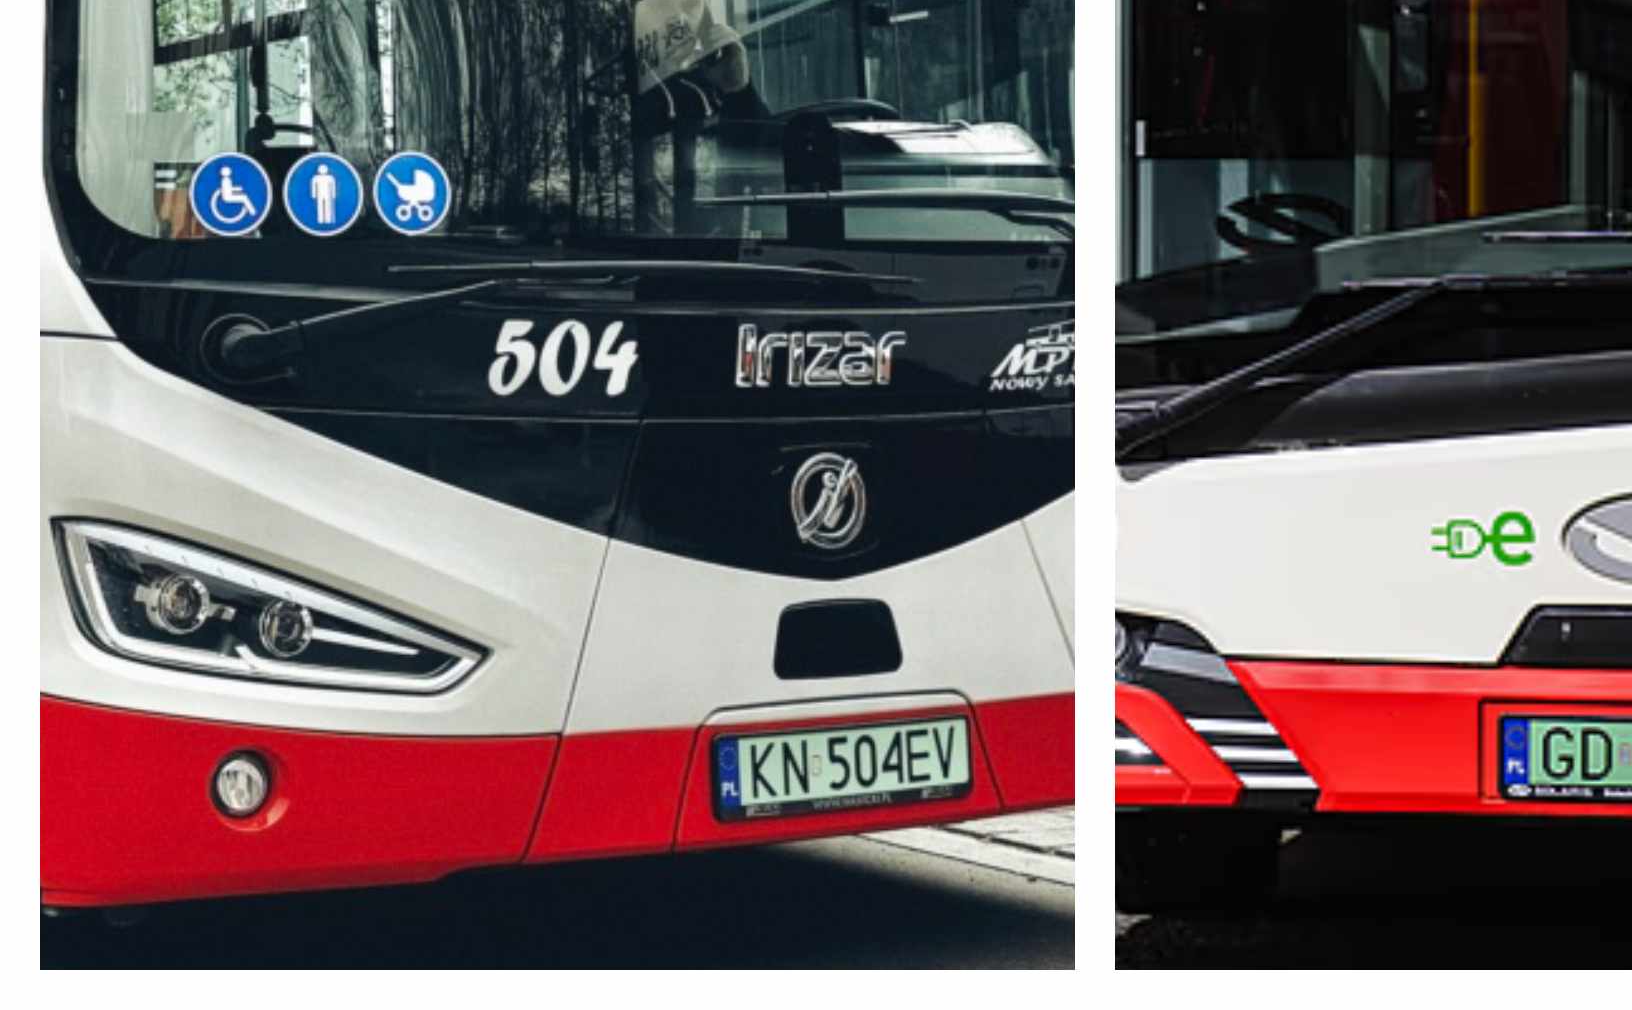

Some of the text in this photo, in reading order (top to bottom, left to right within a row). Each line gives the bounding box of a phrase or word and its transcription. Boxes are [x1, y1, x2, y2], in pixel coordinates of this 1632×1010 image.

[488, 319, 639, 396] 504
[750, 725, 955, 798] KN 504EV
[1542, 726, 1613, 781] GD
[721, 782, 738, 797] PL
